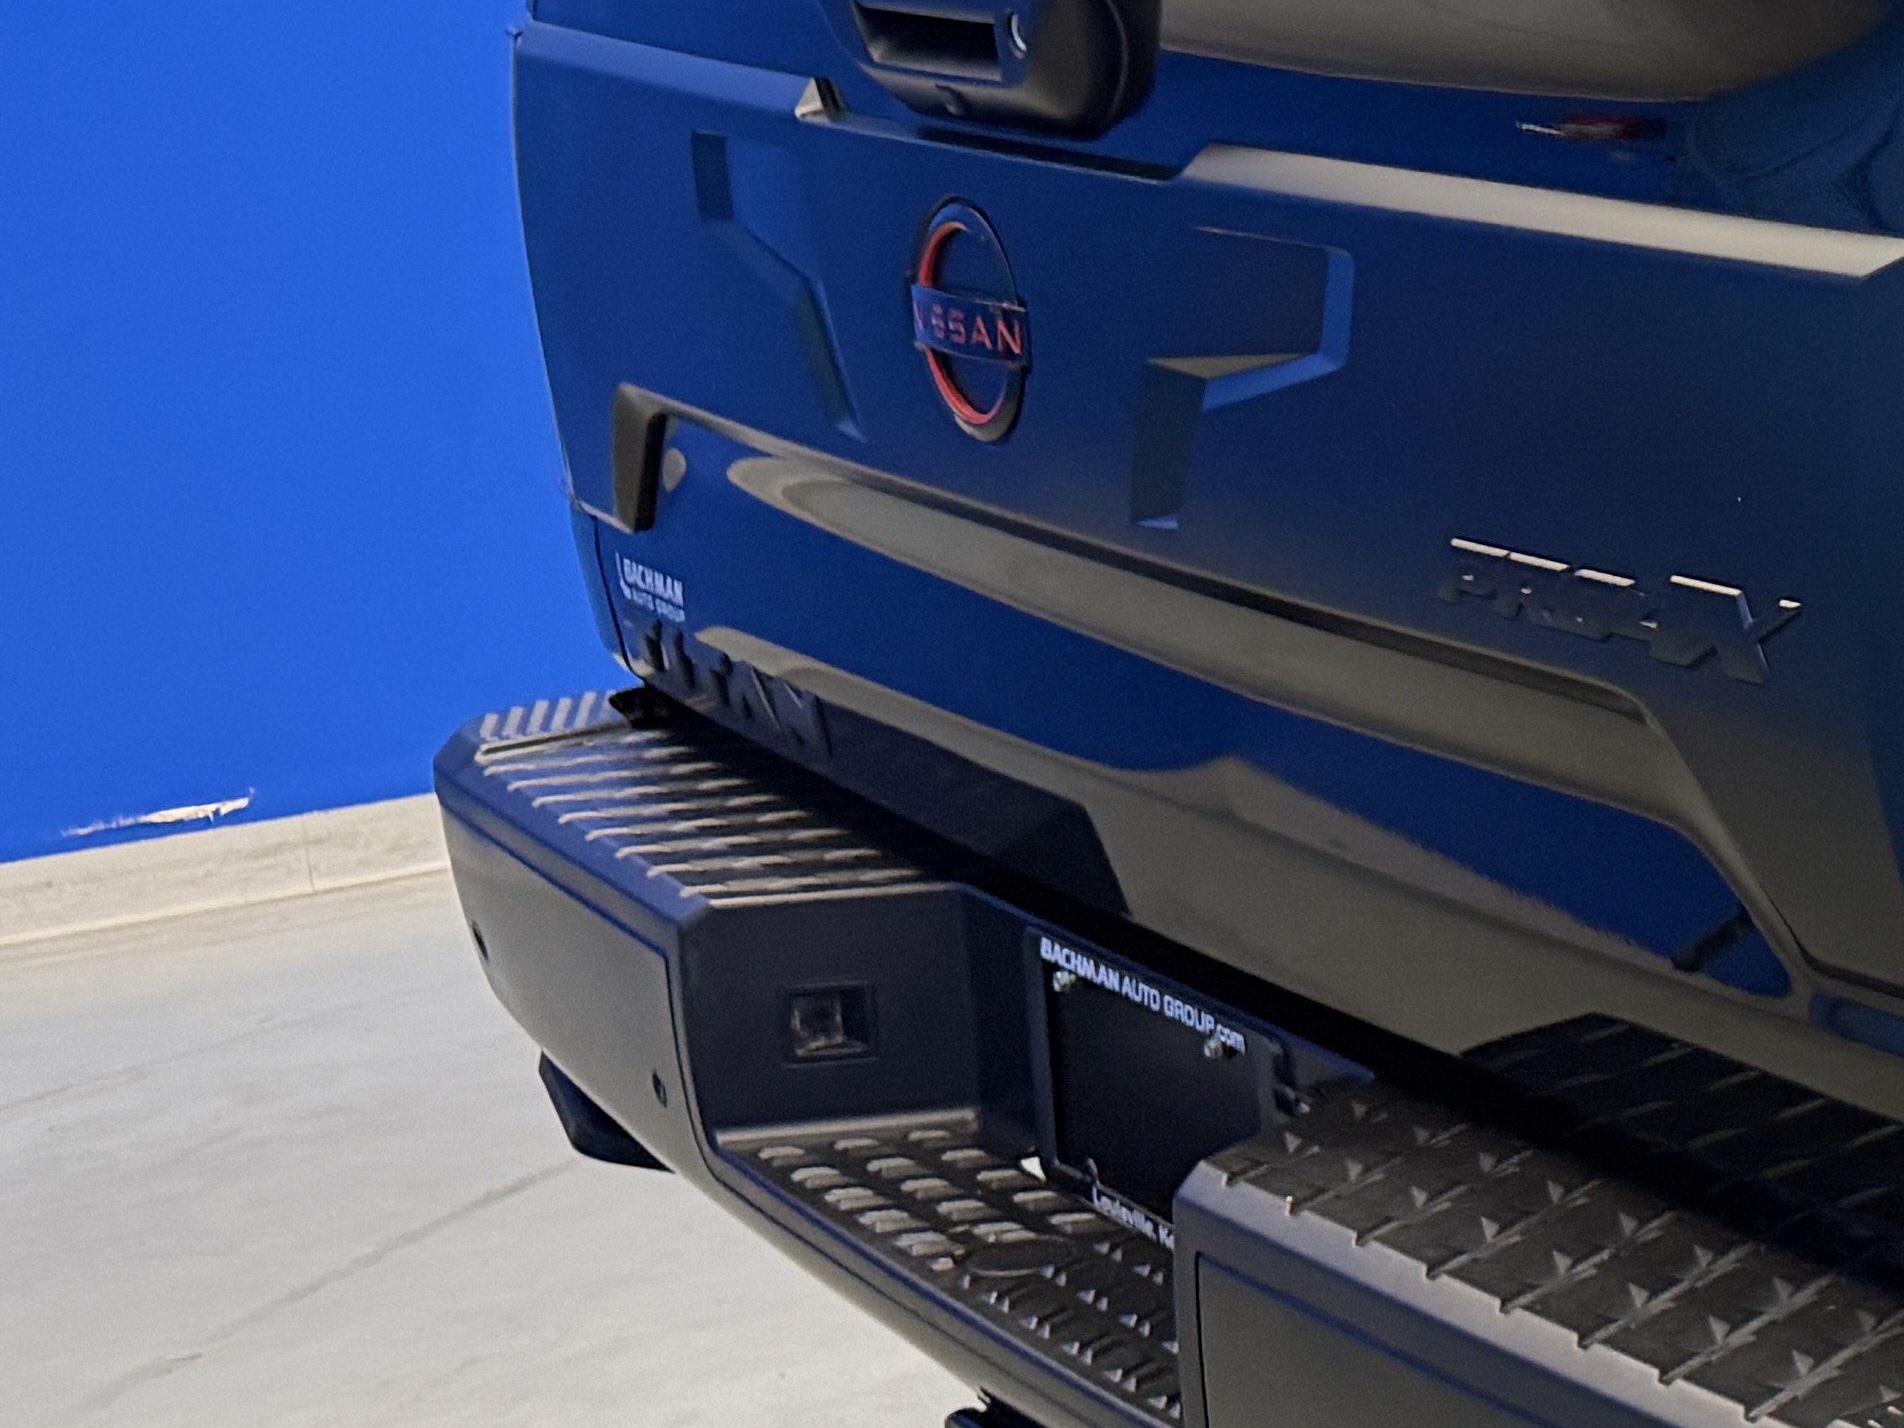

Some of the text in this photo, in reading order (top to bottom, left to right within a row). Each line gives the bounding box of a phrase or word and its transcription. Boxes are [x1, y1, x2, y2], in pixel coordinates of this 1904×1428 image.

[912, 300, 1023, 355] SSAN
[1040, 936, 1120, 993] BACHMAN
[1121, 976, 1161, 1013] AUTO
